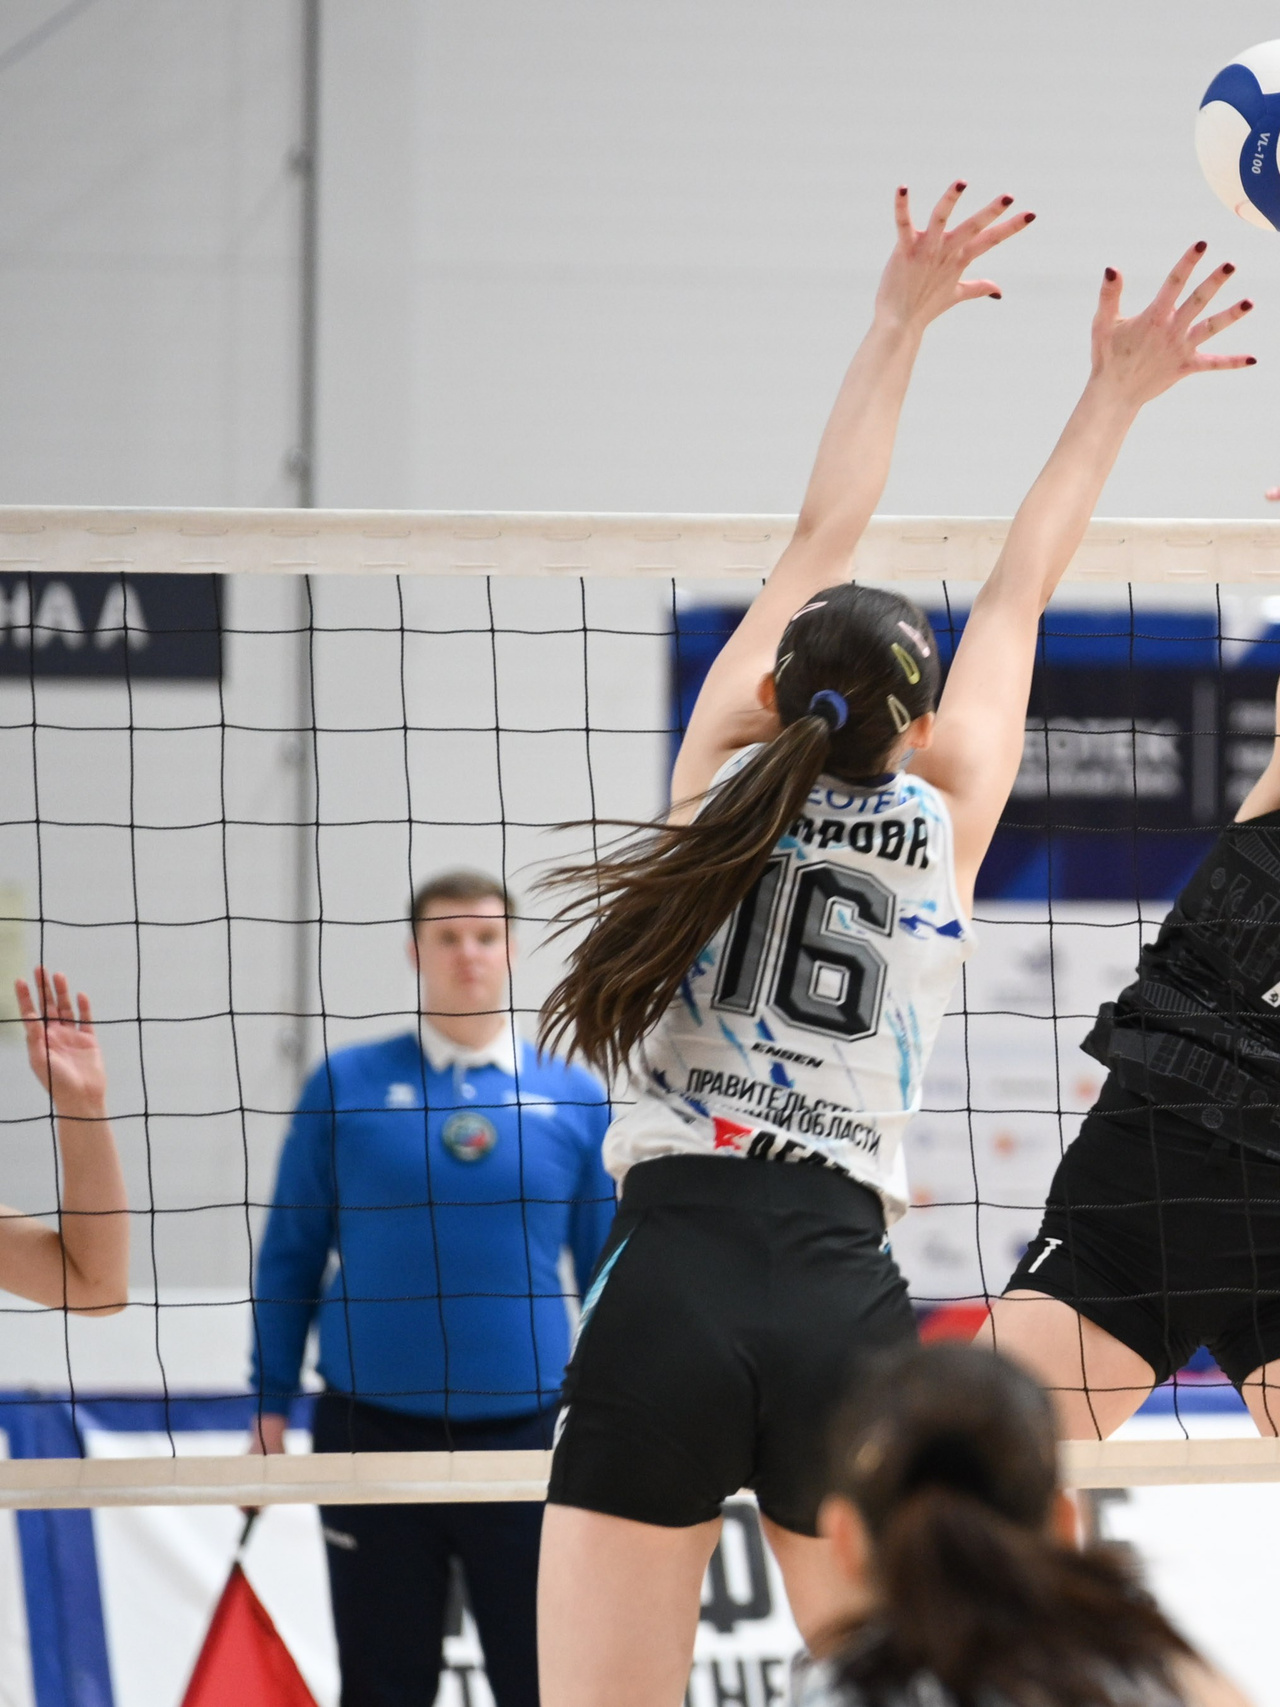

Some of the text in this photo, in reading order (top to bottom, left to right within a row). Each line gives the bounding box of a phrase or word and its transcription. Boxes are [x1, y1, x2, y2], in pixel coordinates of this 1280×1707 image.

[1251, 132, 1271, 174] VL-100
[711, 851, 897, 1043] 16
[686, 1067, 865, 1115] ПРАВИТЕЛЬ
